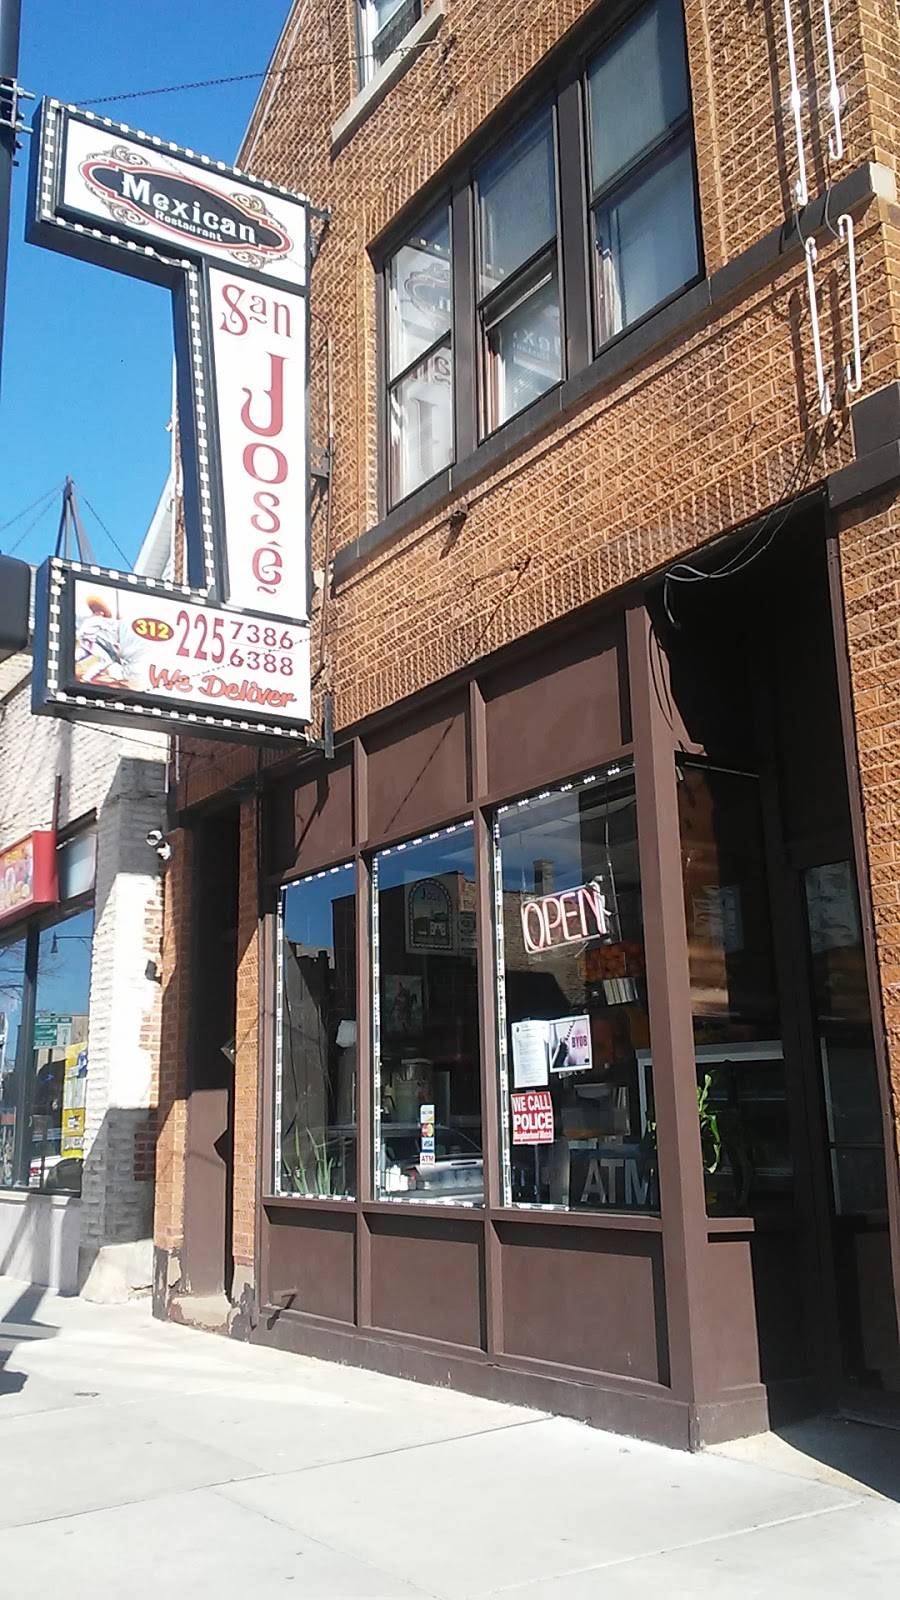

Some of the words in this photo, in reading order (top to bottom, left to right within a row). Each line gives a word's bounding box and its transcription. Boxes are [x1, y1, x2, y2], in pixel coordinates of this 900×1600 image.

[121, 171, 258, 246] Mexican
[219, 283, 292, 338] San
[134, 619, 170, 640] 312
[175, 609, 225, 664] 225
[229, 620, 294, 650] 7386
[148, 663, 193, 692] We
[198, 673, 297, 707] Deliver
[229, 648, 294, 676] 6388
[523, 886, 607, 951] OPEN
[511, 1096, 527, 1112] WE
[527, 1094, 551, 1111] CALL
[513, 1112, 552, 1130] POLICE
[580, 1157, 654, 1206] ATM
